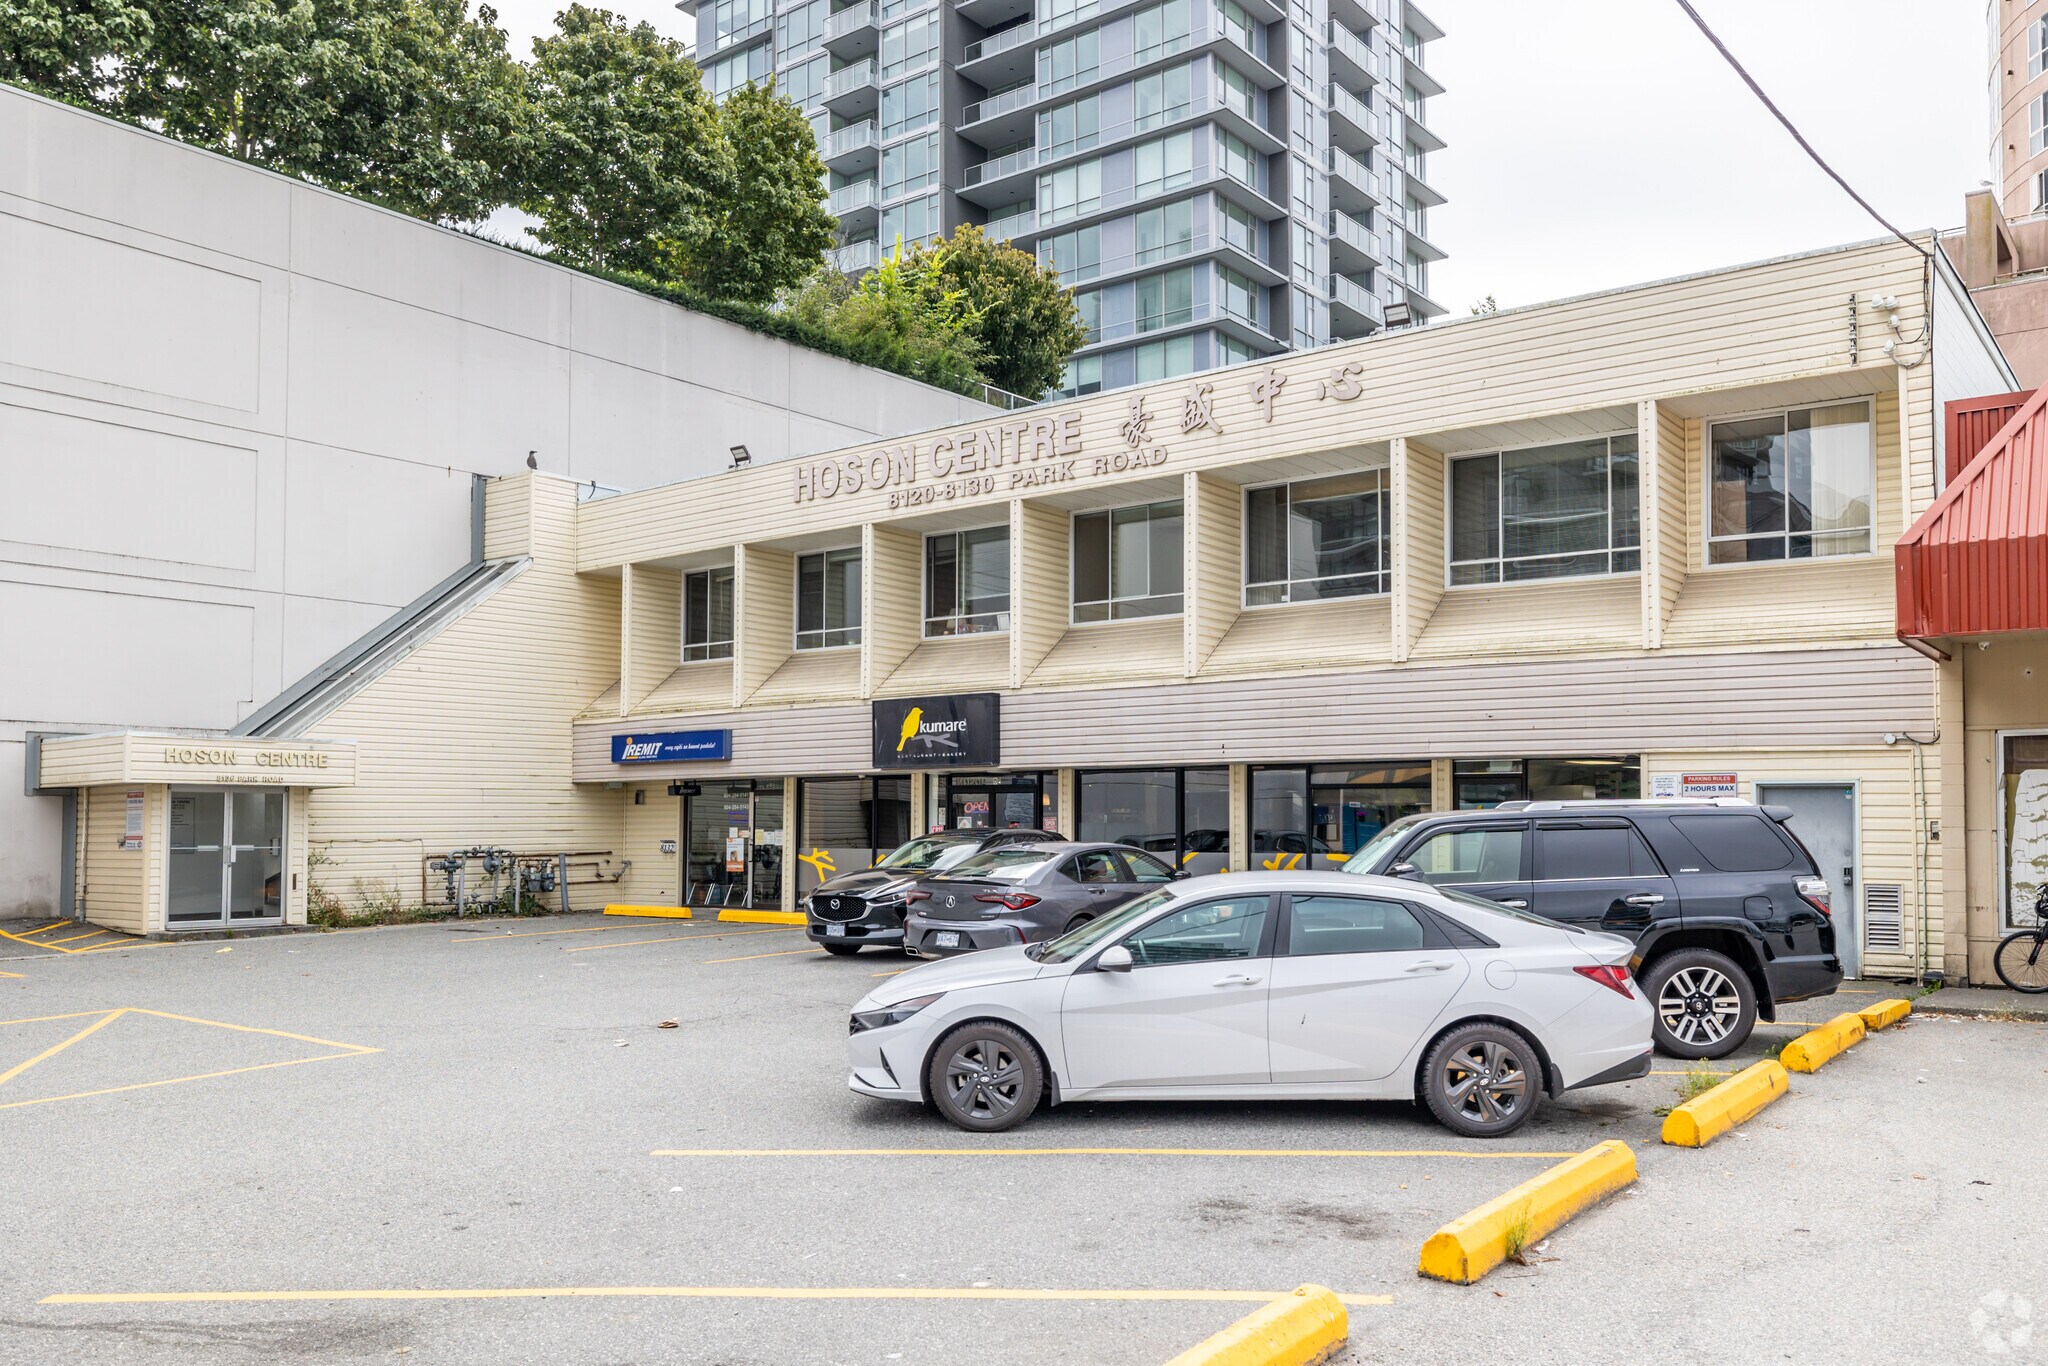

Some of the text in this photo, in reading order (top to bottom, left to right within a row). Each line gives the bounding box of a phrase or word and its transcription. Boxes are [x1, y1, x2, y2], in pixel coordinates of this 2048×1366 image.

[792, 411, 1083, 503] HOSON CENTRE
[889, 445, 1168, 509] 8120-8130 PARK ROAD
[164, 747, 329, 768] HOSON CENTRE
[964, 801, 990, 814] OPEN
